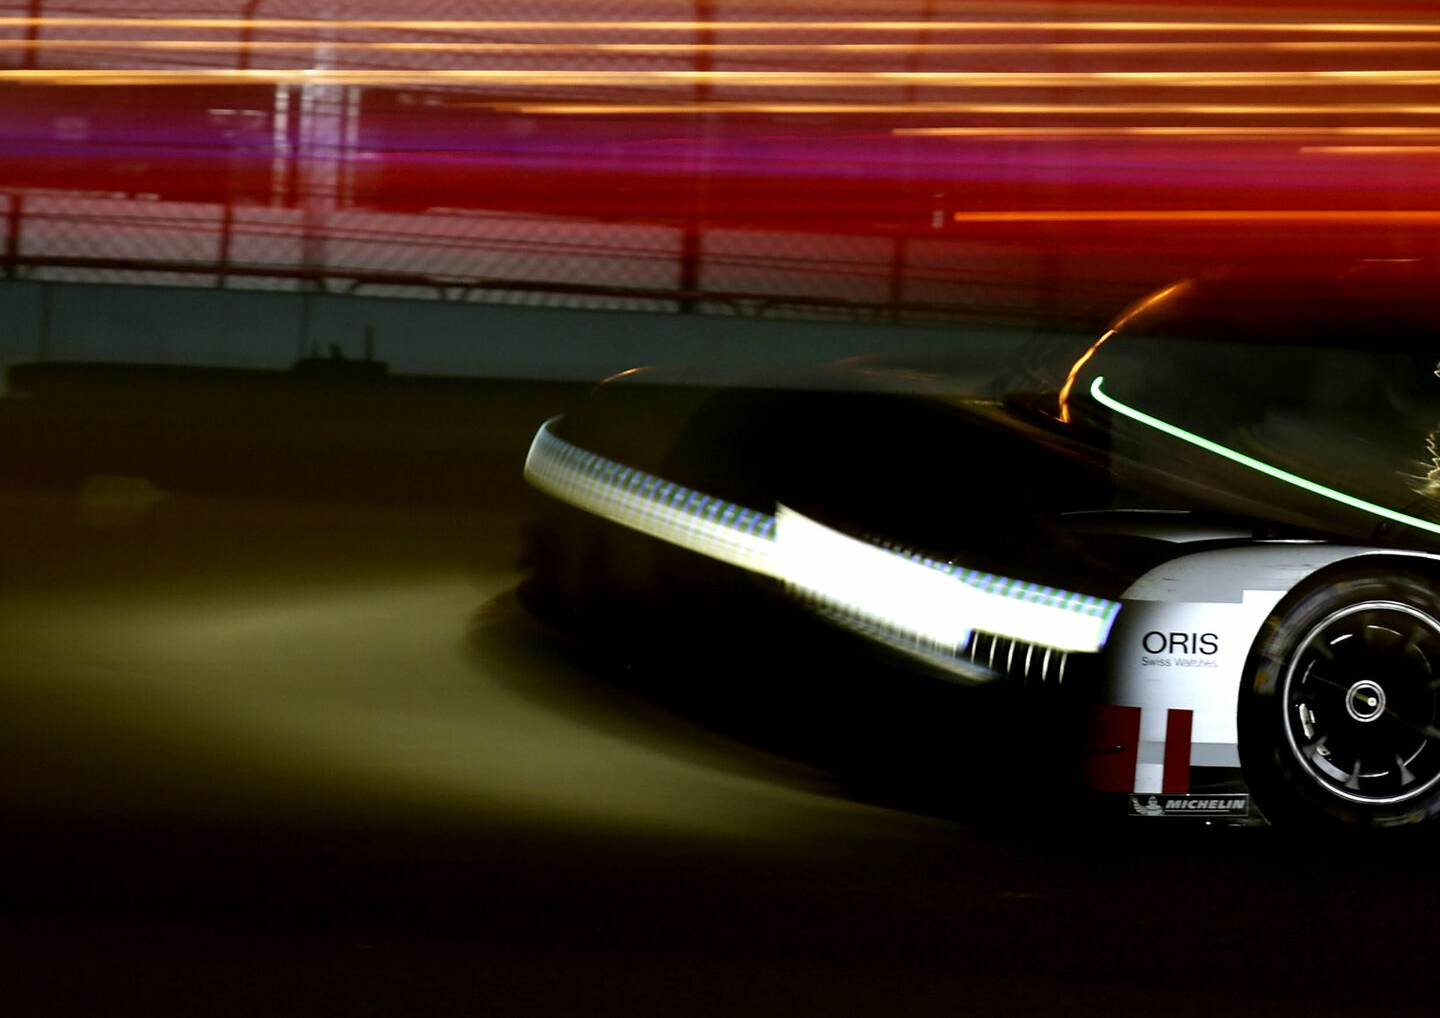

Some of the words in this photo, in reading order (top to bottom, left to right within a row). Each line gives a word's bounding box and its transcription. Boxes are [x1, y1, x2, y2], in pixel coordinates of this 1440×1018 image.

[1142, 631, 1218, 655] ORIS
[1141, 656, 1171, 667] Swiss
[1165, 799, 1246, 809] MICHELIN
